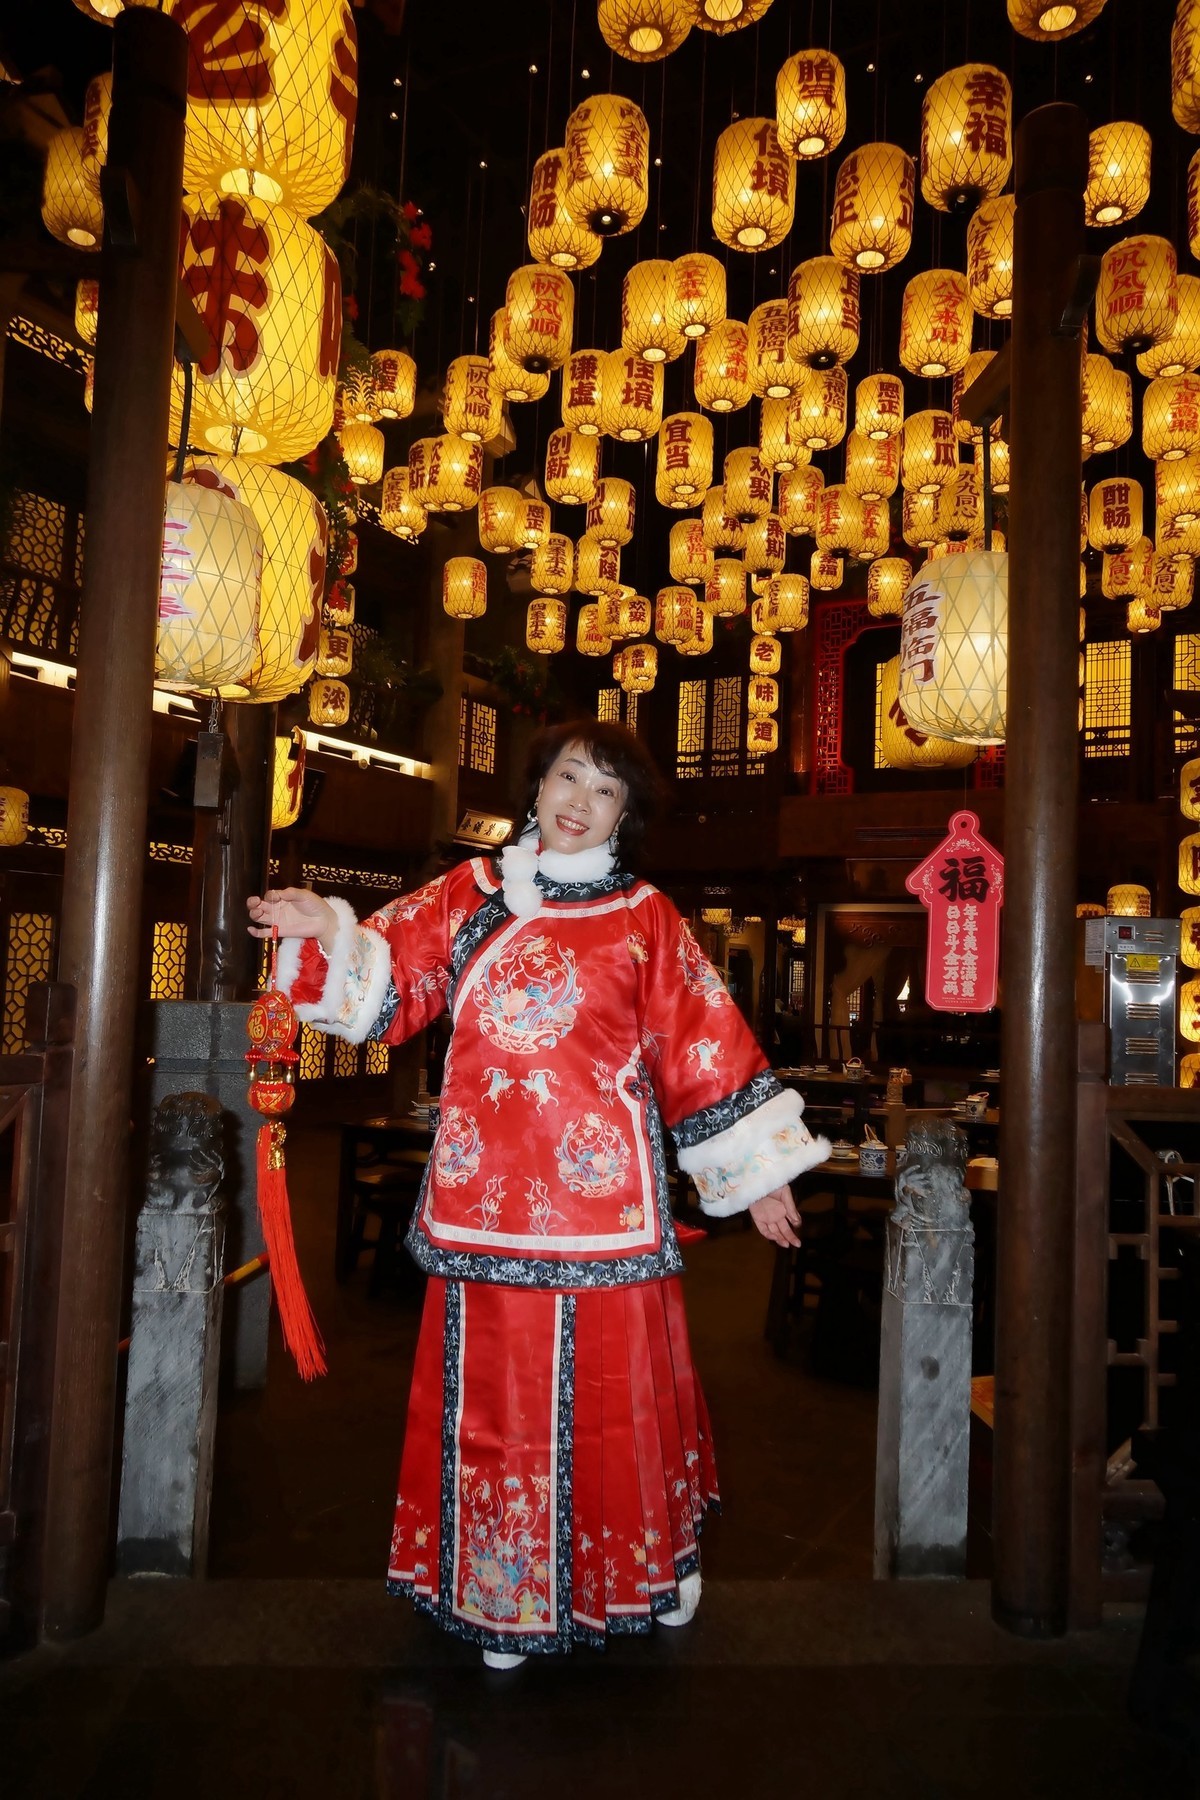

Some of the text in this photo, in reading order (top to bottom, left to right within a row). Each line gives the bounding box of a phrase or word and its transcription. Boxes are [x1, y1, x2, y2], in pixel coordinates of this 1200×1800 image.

[966, 72, 1006, 161] 幸福
[568, 353, 599, 408] 谦虚
[546, 431, 573, 481] 创新
[1102, 482, 1132, 532] 酣畅
[755, 641, 775, 742] 老味道
[938, 855, 990, 903] 福
